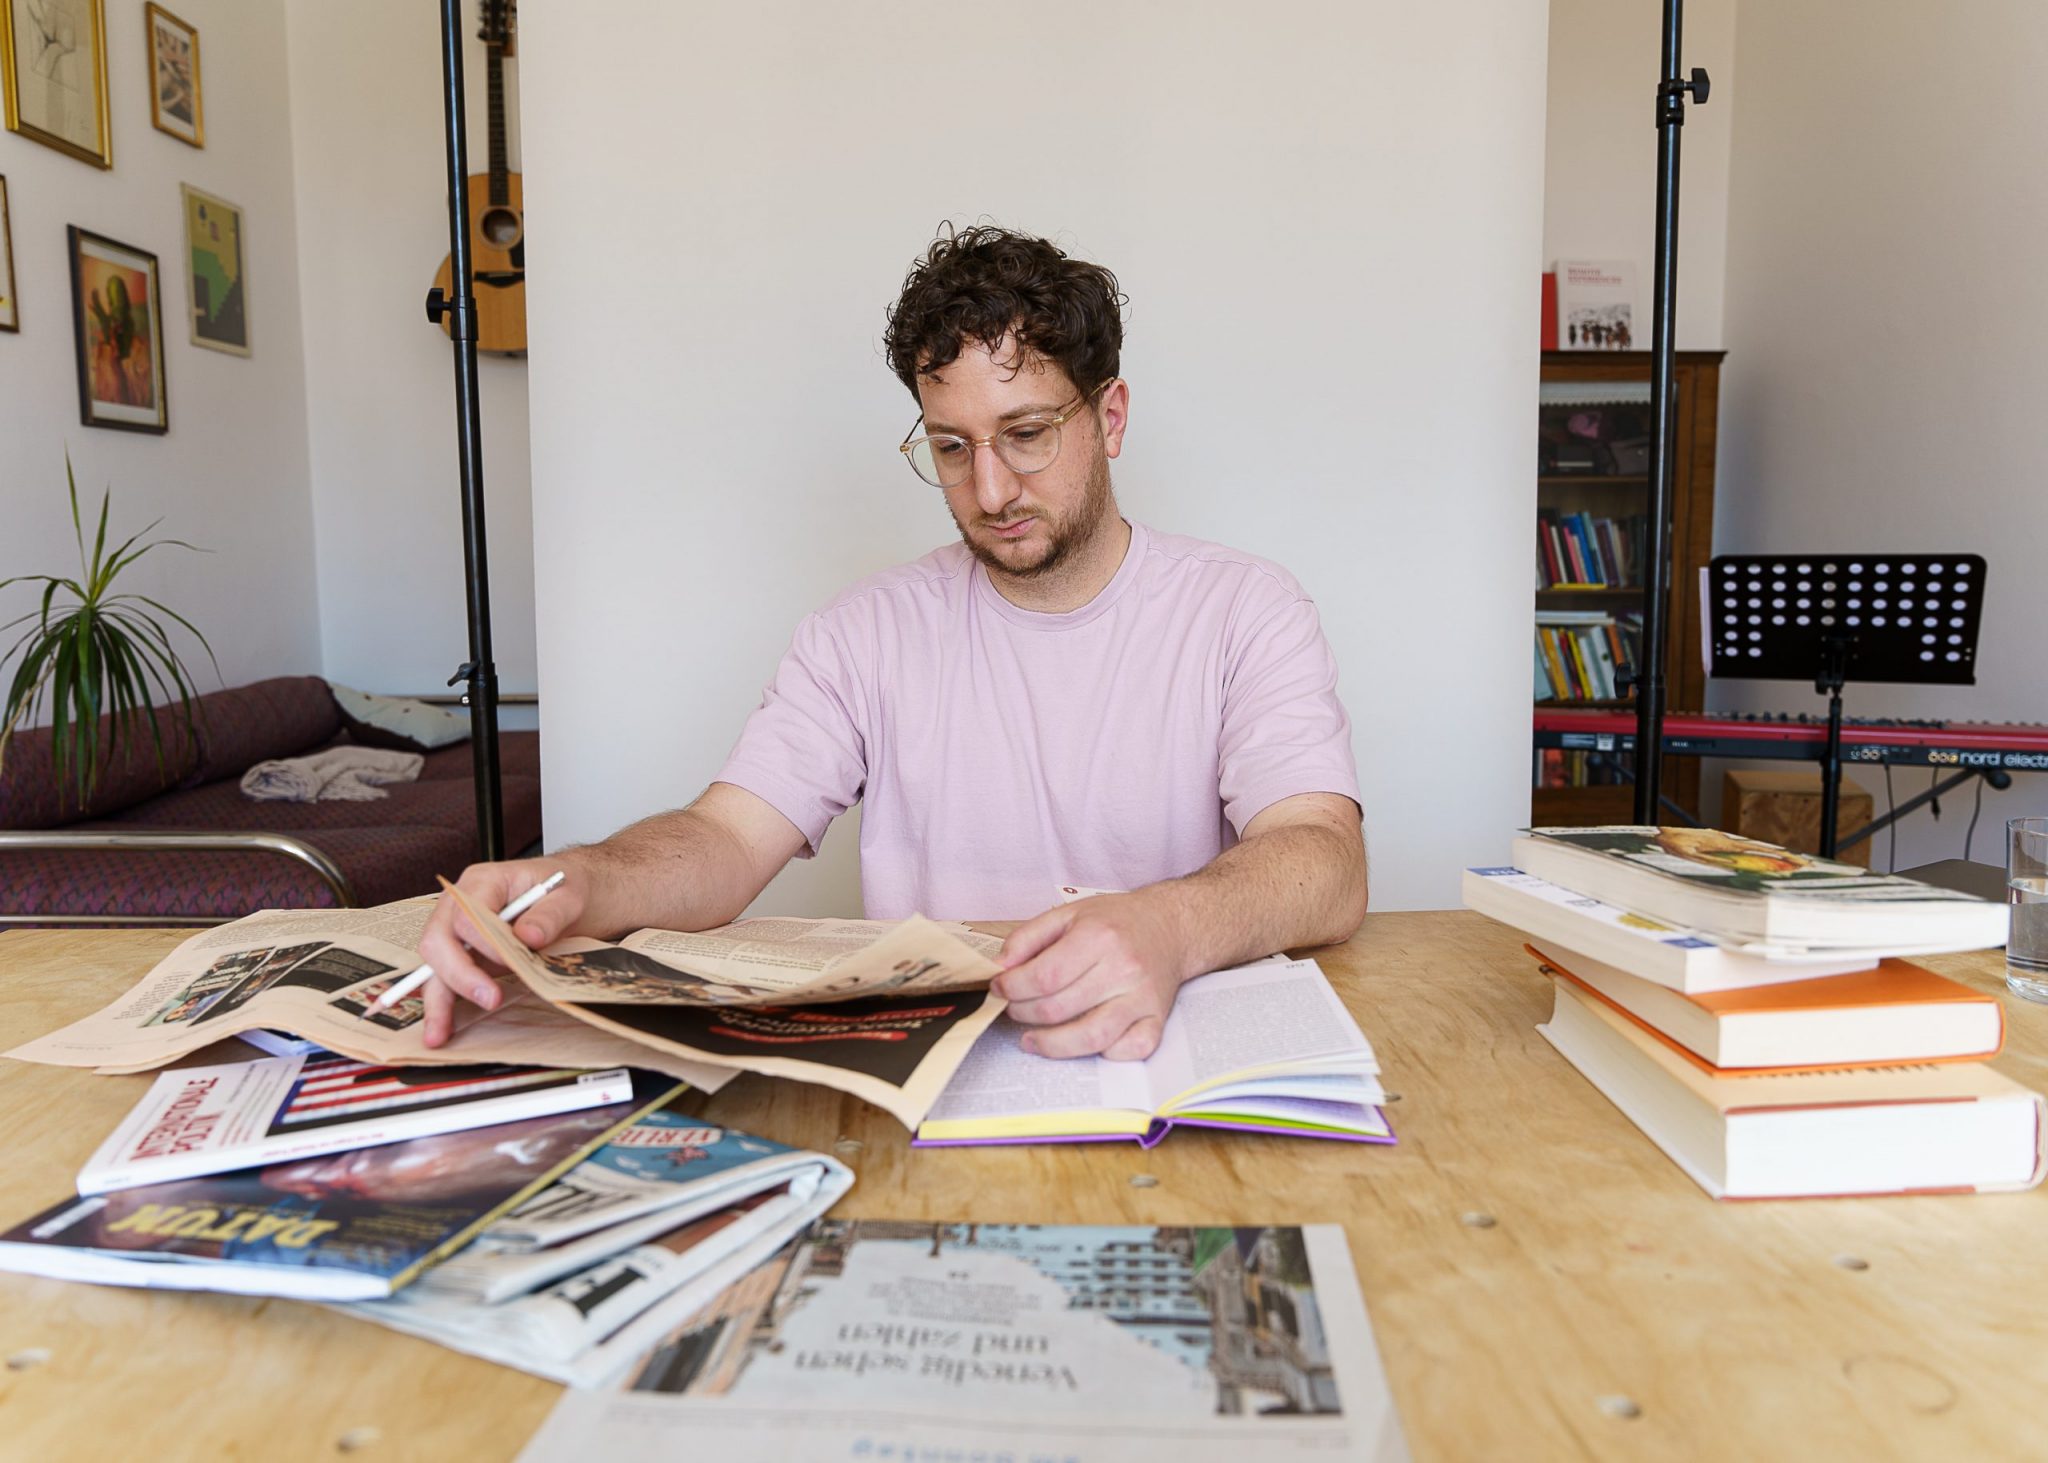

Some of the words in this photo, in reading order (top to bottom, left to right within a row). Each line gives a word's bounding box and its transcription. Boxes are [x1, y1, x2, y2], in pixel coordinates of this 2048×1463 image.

[1960, 751, 2001, 766] nord
[129, 1076, 220, 1162] INTERNATIONALE
[168, 1110, 226, 1155] POLITIK
[106, 1203, 340, 1248] DATUM
[836, 1323, 961, 1350] zahlen
[971, 1333, 1050, 1356] und
[794, 1350, 908, 1377] sehen
[919, 1354, 1079, 1391] Venedig
